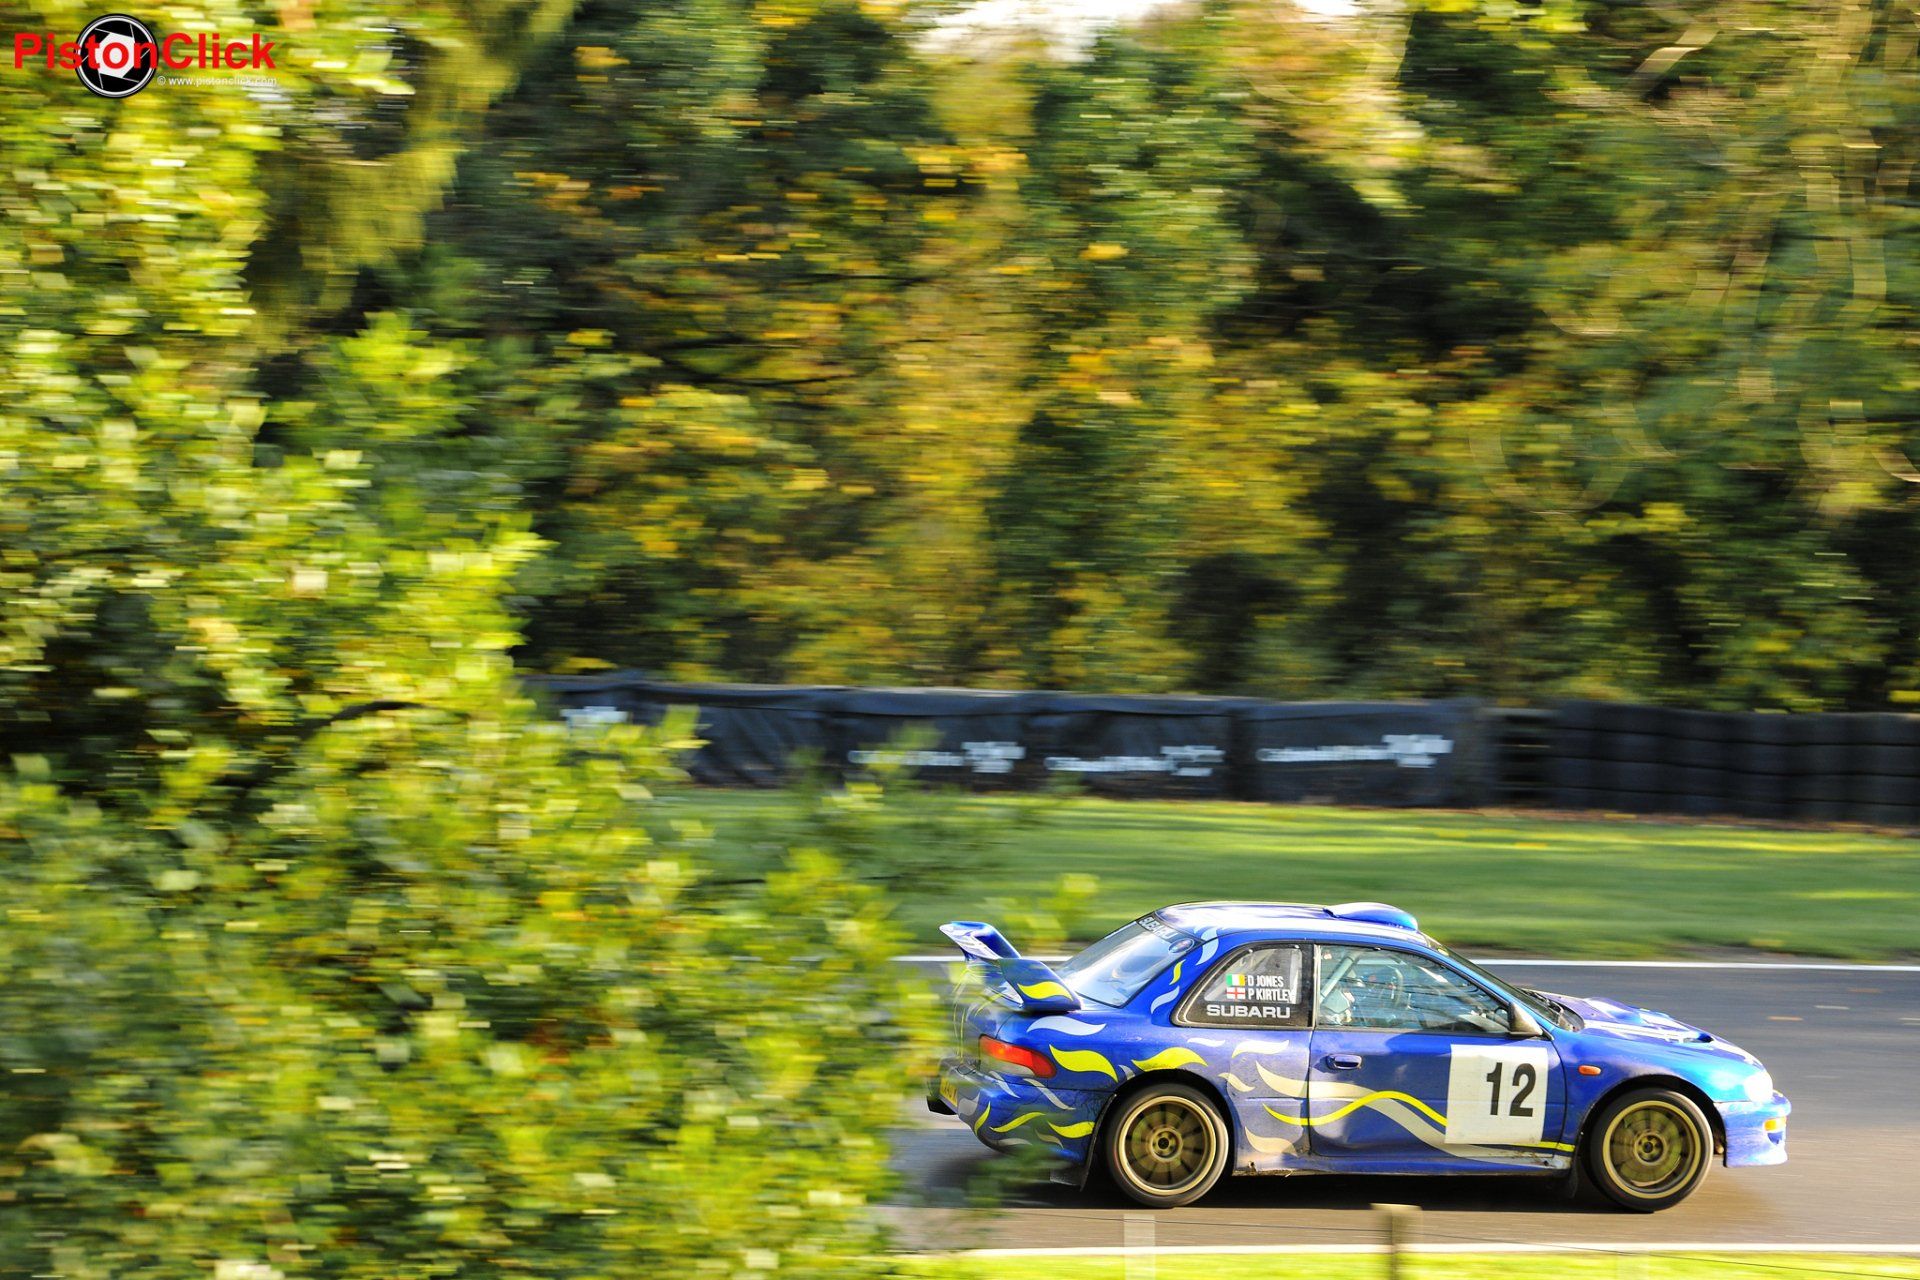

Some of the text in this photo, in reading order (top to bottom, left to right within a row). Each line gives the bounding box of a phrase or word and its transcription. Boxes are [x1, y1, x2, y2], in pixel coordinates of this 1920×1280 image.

[1247, 975, 1284, 988] D JONES
[1248, 988, 1254, 1000] P
[1206, 1004, 1291, 1019] SUBARU
[1486, 1062, 1537, 1117] 12
